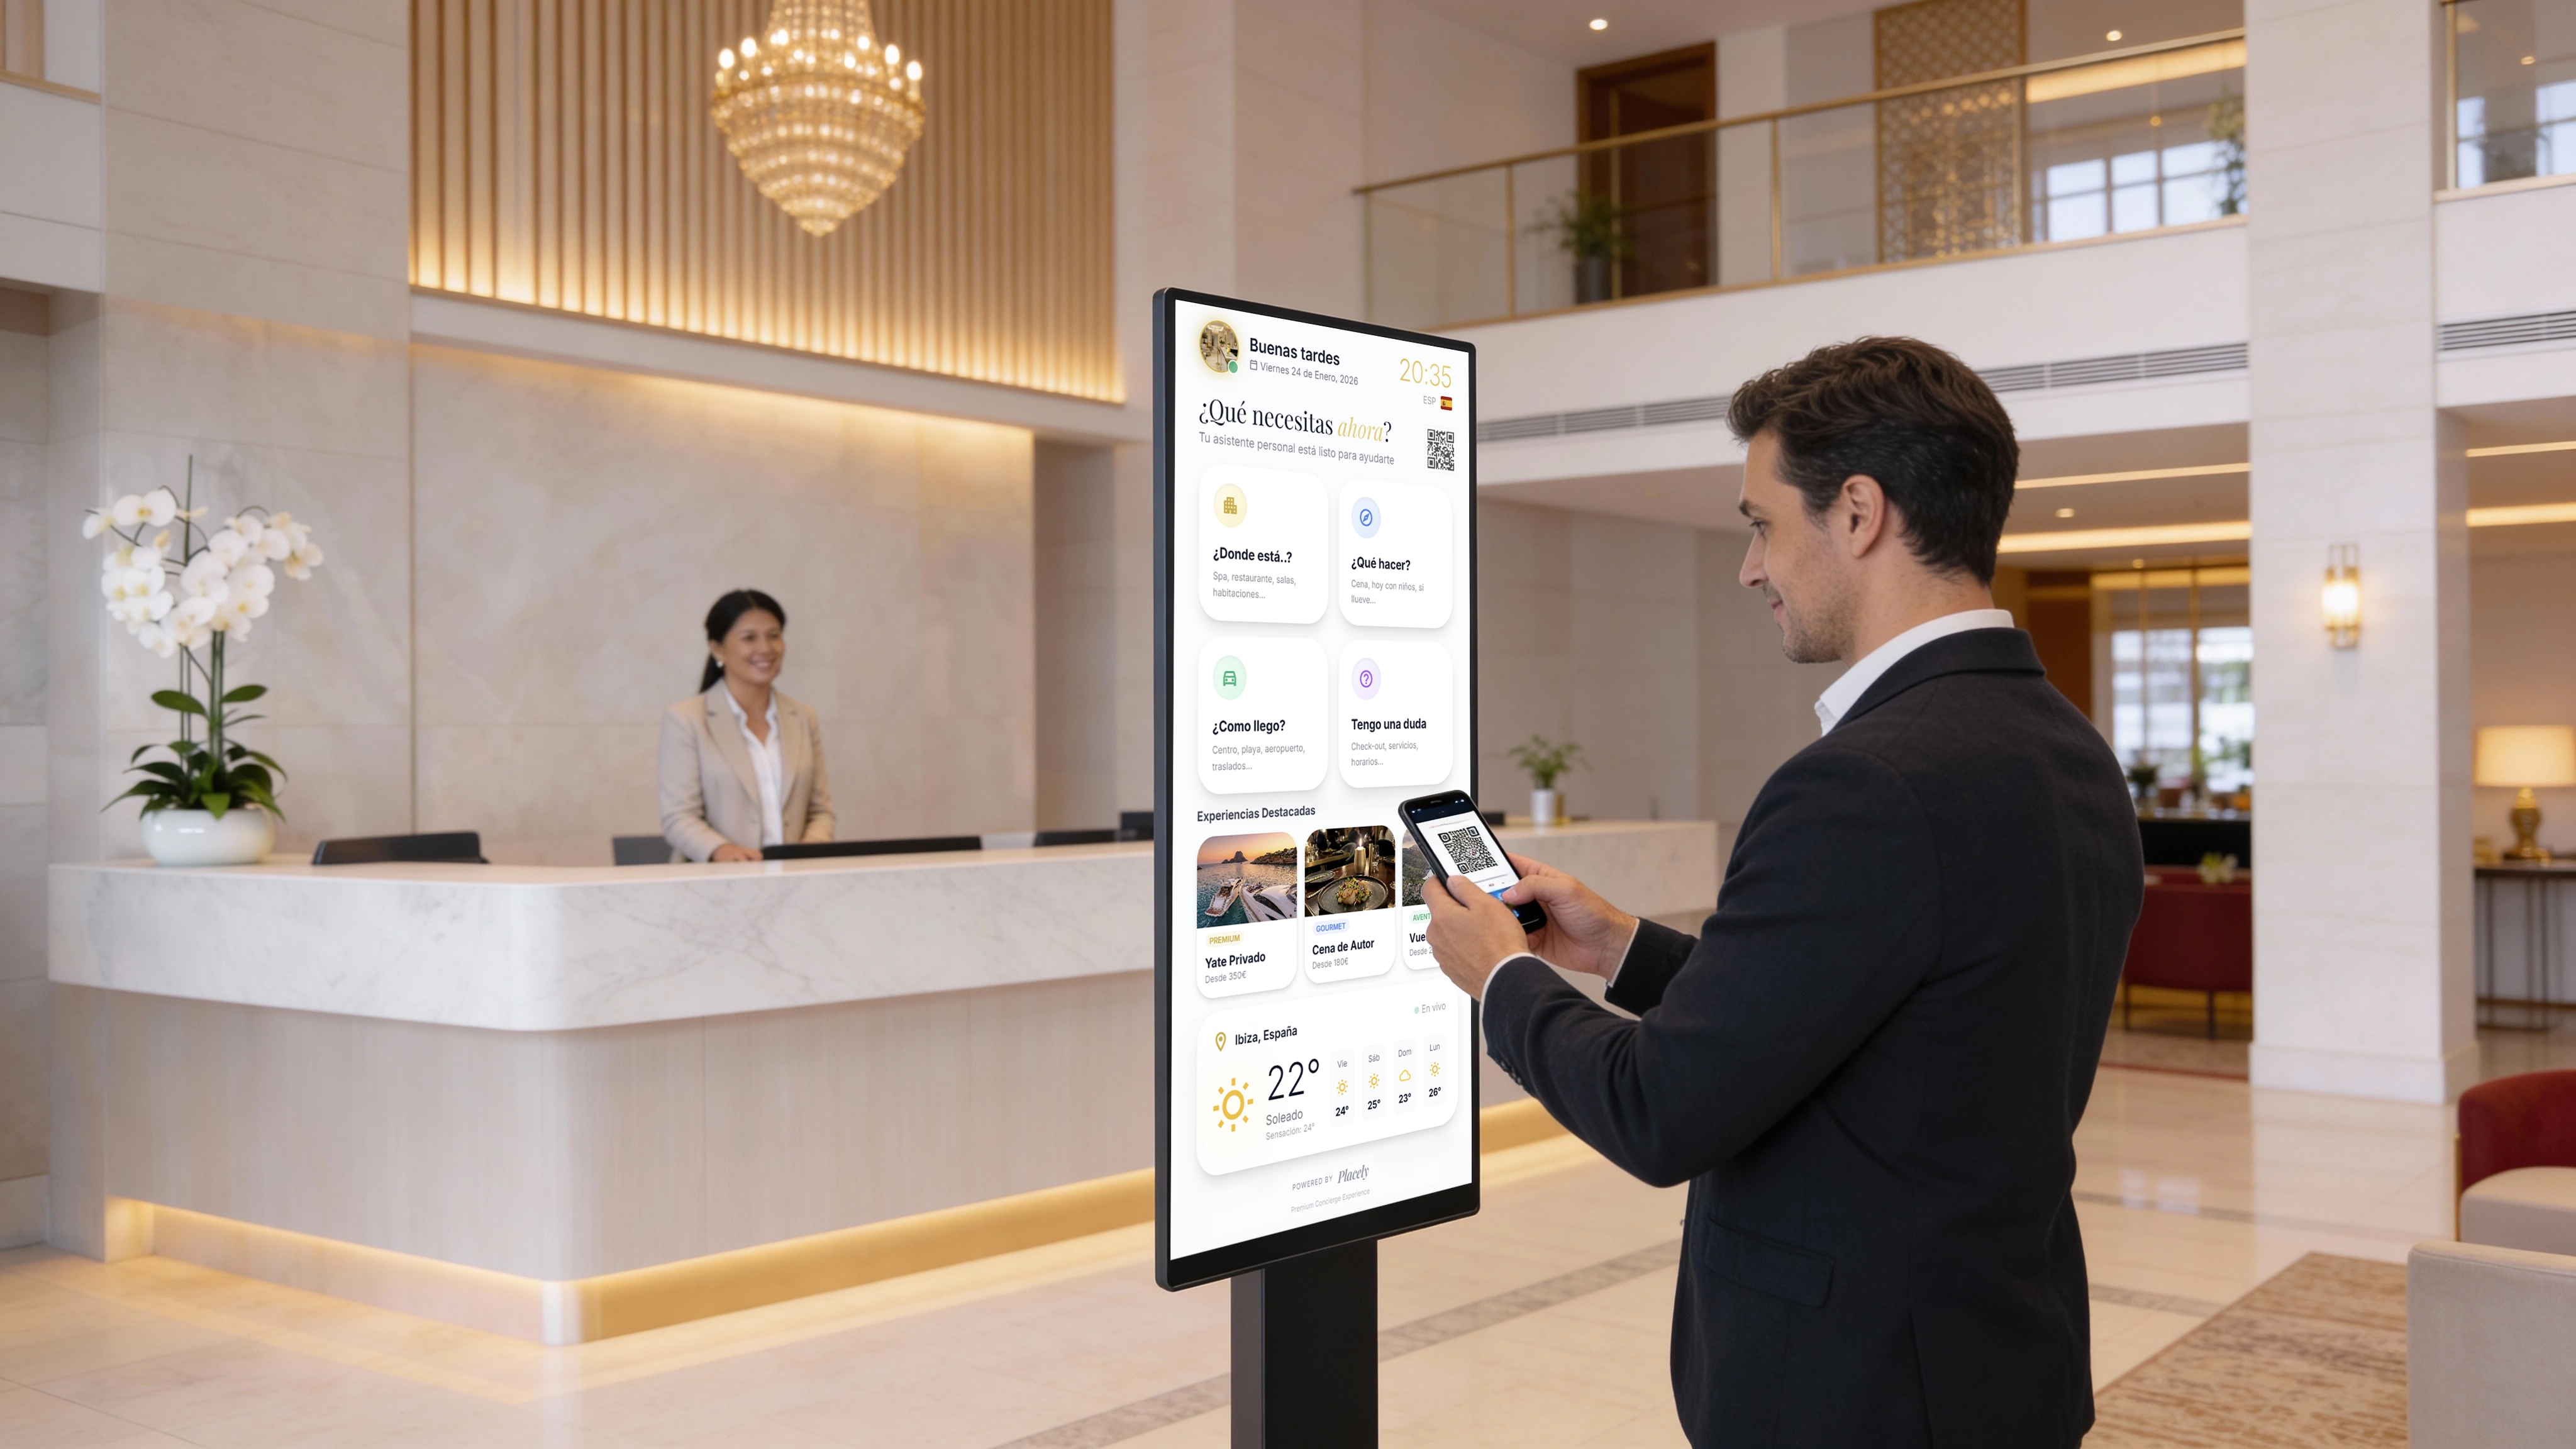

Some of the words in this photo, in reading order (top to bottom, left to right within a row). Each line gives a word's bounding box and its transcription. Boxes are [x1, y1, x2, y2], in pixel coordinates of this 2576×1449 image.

[1250, 338, 1297, 358] Buenas
[1301, 347, 1340, 365] tardes
[1260, 362, 1289, 375] Viernes
[1292, 367, 1301, 376] 24
[1303, 369, 1313, 378] de
[1315, 370, 1337, 383] Enero,
[1340, 374, 1358, 386] 2026
[1400, 358, 1452, 388] 20:35
[1423, 396, 1436, 405] ESP
[1199, 399, 1246, 426] ¿Qué
[1252, 410, 1333, 435] necesitas
[1338, 417, 1392, 443] ahora?
[1199, 431, 1210, 443] Tu
[1213, 435, 1255, 448] asistente
[1257, 441, 1295, 453] personal
[1298, 445, 1316, 455] está
[1319, 446, 1336, 458] listo
[1338, 451, 1357, 461] para
[1359, 453, 1394, 465] ayudarte
[1213, 547, 1255, 561] ¿Donde
[1257, 550, 1292, 563] está..?
[1352, 557, 1376, 570] ¿Qué
[1379, 558, 1411, 570] hacer?
[1213, 571, 1229, 582] Spa,
[1231, 574, 1274, 585] restaurante,
[1276, 575, 1296, 586] salas,
[1352, 579, 1370, 590] Cena,
[1372, 580, 1384, 591] hoy
[1399, 582, 1417, 592] niños,
[1213, 588, 1265, 599] habitaciones...
[1352, 595, 1375, 604] llueve...
[1213, 720, 1251, 735] ¿Como
[1254, 719, 1285, 735] llego?
[1352, 719, 1381, 733] Tengo
[1384, 721, 1401, 730] una
[1403, 718, 1426, 729] duda
[1213, 745, 1239, 755] Centro,
[1241, 745, 1262, 755] playa,
[1265, 745, 1305, 754] aeropuerto,
[1352, 742, 1387, 752] Check-out,
[1389, 741, 1418, 750] servicios,
[1212, 762, 1252, 771] traslados...
[1352, 757, 1384, 766] horarios...
[1197, 808, 1260, 824] Experiencias
[1262, 806, 1316, 818] Destacadas
[1413, 913, 1431, 922] AVENT
[1316, 922, 1346, 932] GOURMET
[1209, 935, 1240, 945] PREMIUM
[1409, 932, 1426, 943] Vue
[1313, 945, 1335, 955] Cena
[1337, 941, 1348, 952] de
[1350, 940, 1374, 950] Autor
[1409, 948, 1428, 957] Desde
[1205, 957, 1227, 969] Yate
[1230, 952, 1265, 966] Privado
[1313, 960, 1332, 969] Desde
[1334, 957, 1348, 966] 180€
[1205, 974, 1227, 984] Desde
[1229, 970, 1246, 980] 350€
[1422, 1004, 1430, 1013] En
[1432, 1002, 1446, 1011] vivo
[1235, 1033, 1260, 1045] Ibiza,
[1263, 1026, 1297, 1041] España
[1368, 1054, 1380, 1063] Sáb
[1398, 1049, 1411, 1057] Dom
[1337, 1060, 1347, 1068] Vie
[1269, 1058, 1319, 1101] 22°
[1429, 1087, 1441, 1097] 26°
[1368, 1099, 1380, 1110] 25°
[1399, 1093, 1411, 1104] 23°
[1336, 1106, 1349, 1116] 24°
[1266, 1109, 1303, 1126] Soleado
[1266, 1126, 1301, 1140] Sensación:
[1304, 1123, 1314, 1132] 24°
[1292, 1177, 1323, 1191] POWERED
[1338, 1165, 1369, 1184] Placely
[1291, 1203, 1314, 1213] Premium
[1315, 1196, 1341, 1208] Concierge
[1342, 1189, 1370, 1201] Experience
